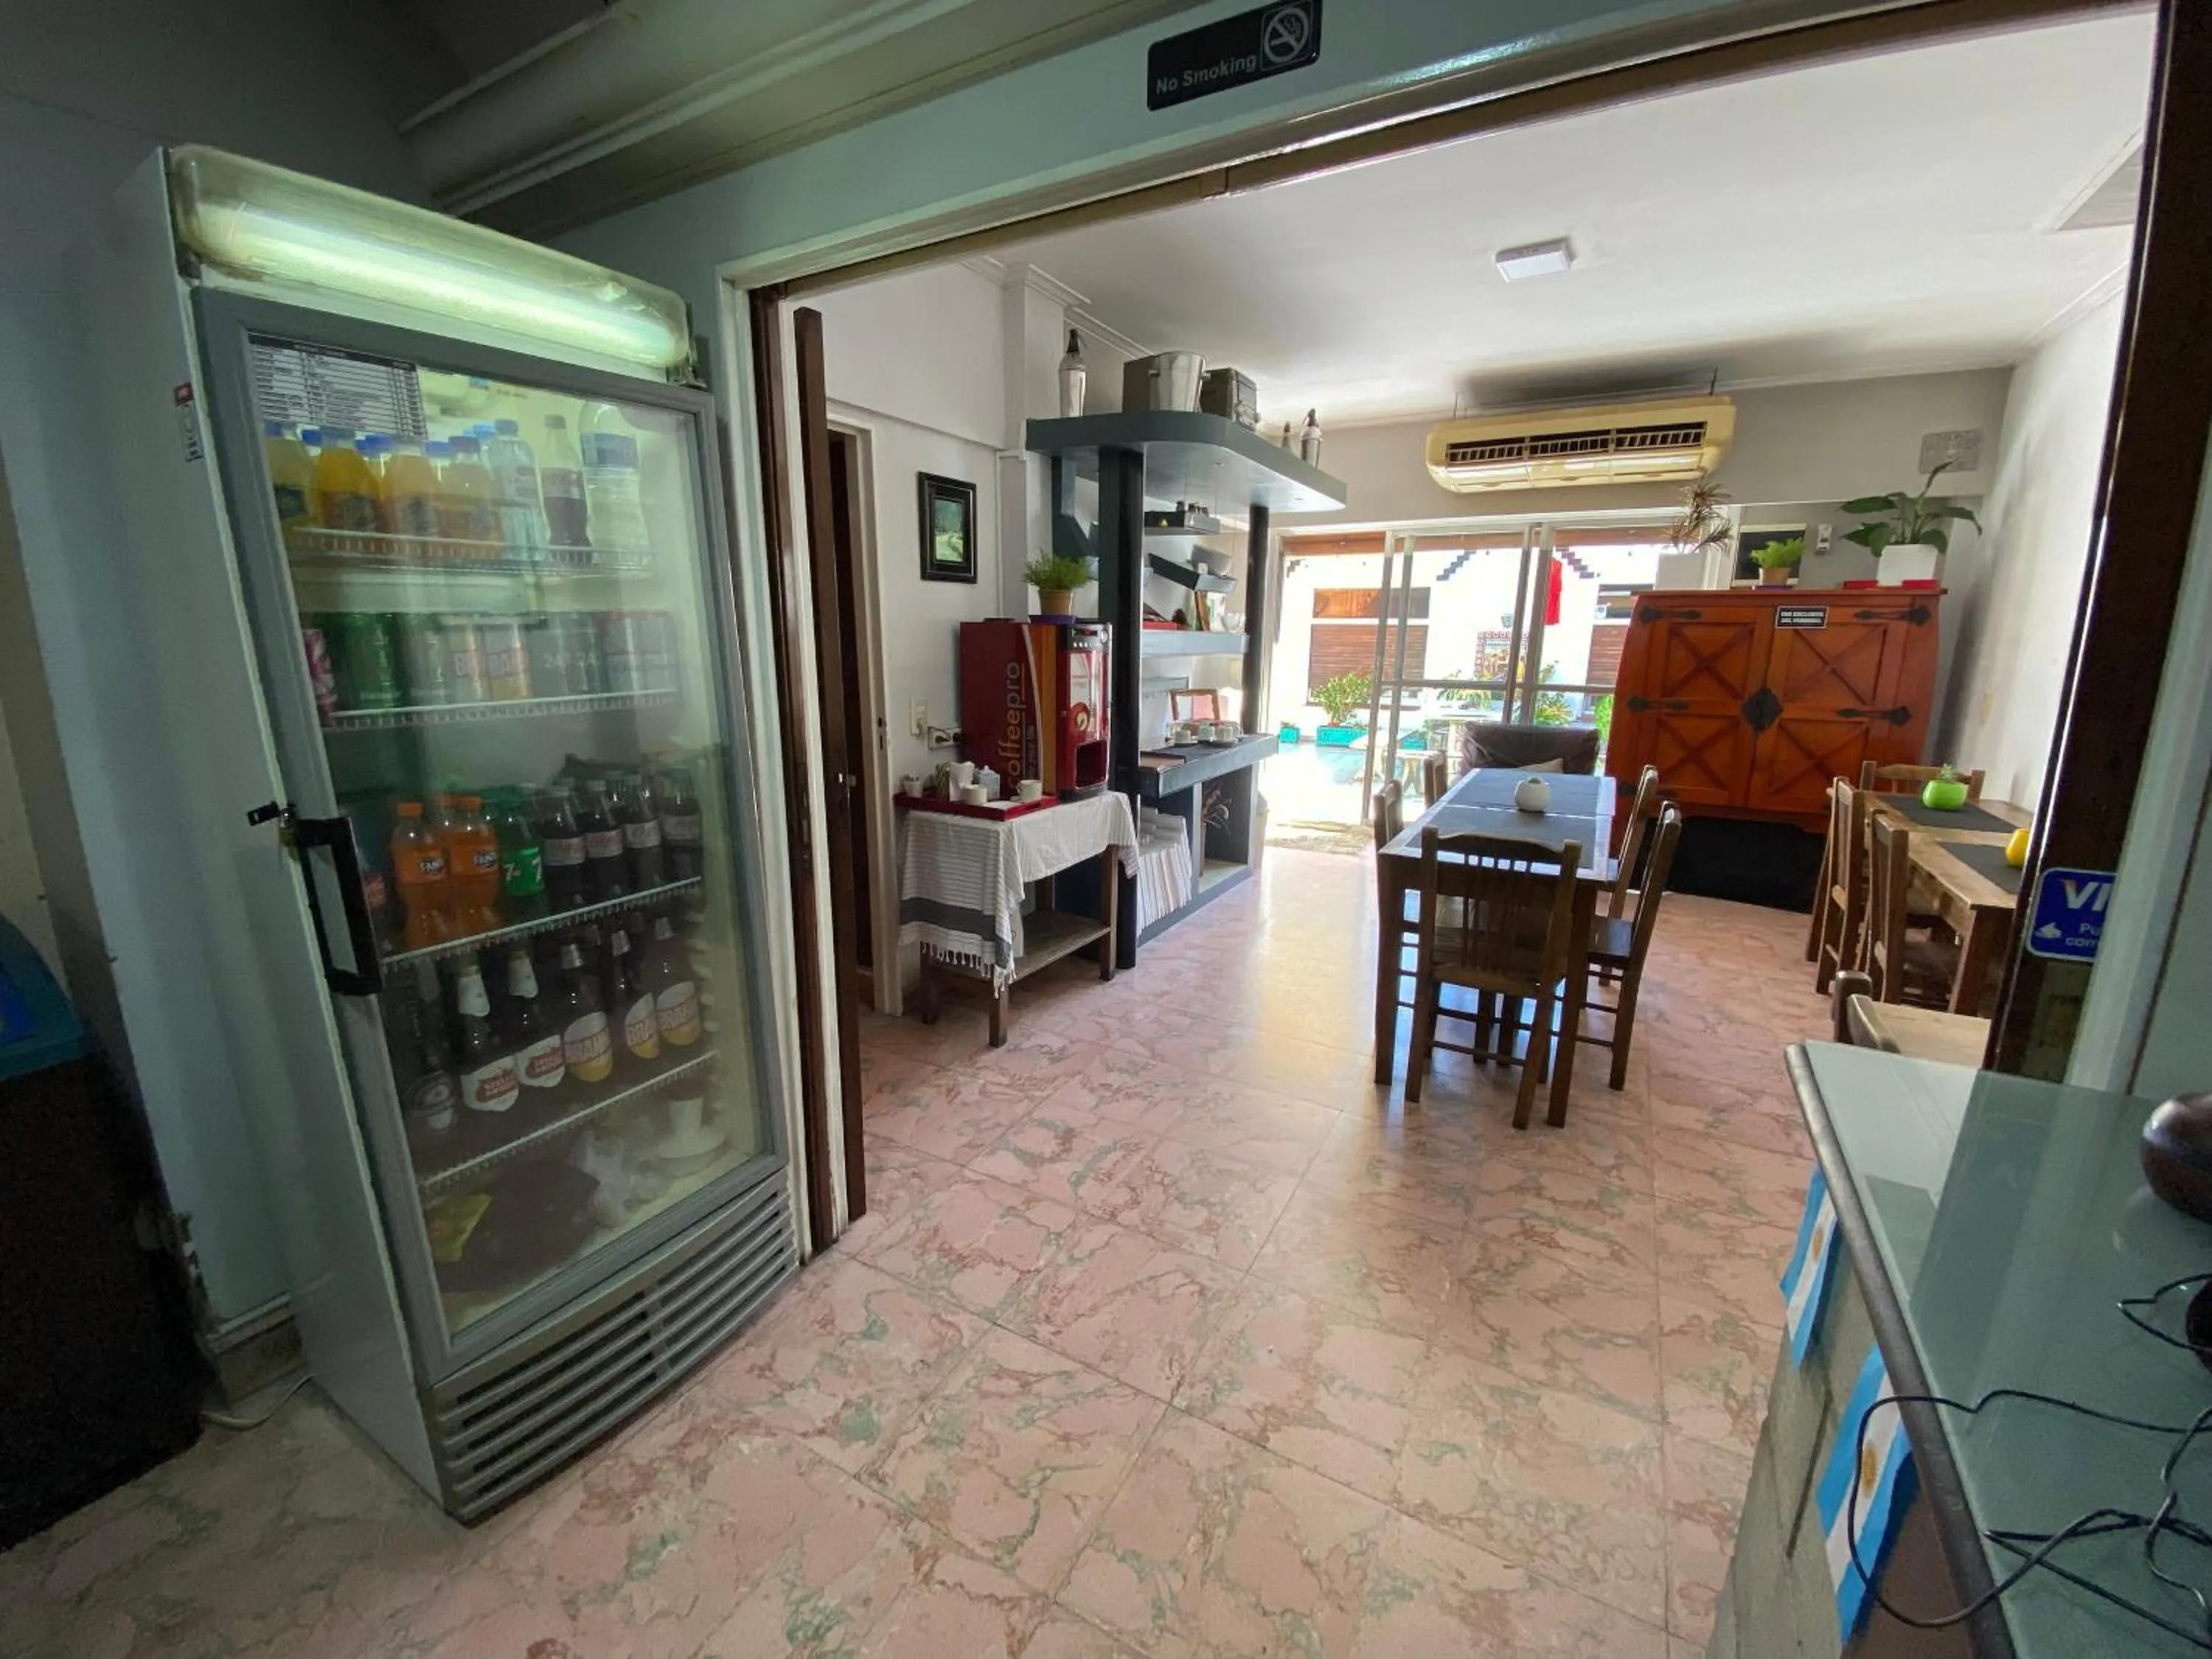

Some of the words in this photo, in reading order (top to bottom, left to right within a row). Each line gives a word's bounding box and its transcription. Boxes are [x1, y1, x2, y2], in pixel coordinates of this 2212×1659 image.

[1155, 76, 1179, 95] No
[1182, 55, 1257, 87] Smoking
[997, 662, 1027, 790] coffeepro
